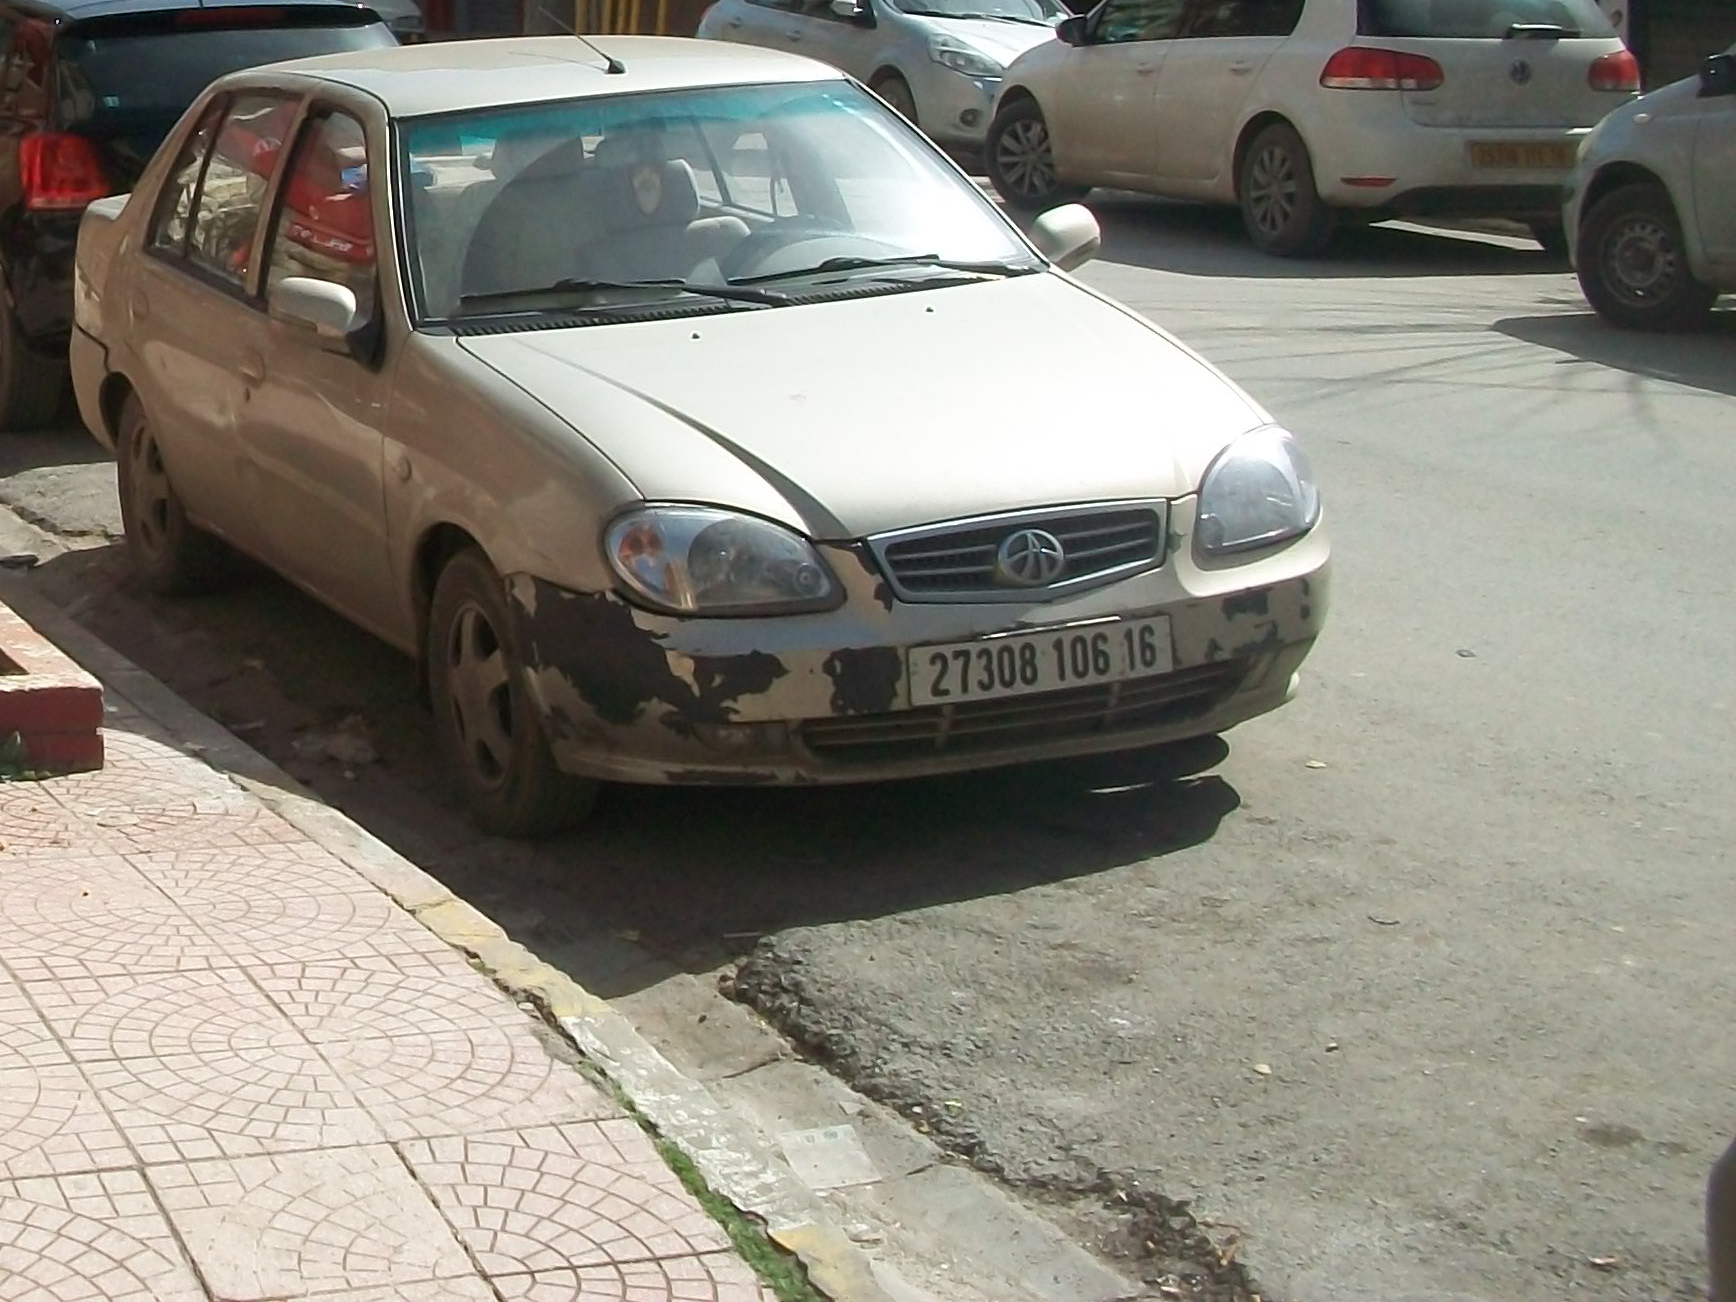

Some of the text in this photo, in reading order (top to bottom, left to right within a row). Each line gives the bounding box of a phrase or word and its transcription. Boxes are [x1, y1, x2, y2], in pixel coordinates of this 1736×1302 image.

[930, 623, 1157, 698] 27308 106 16
